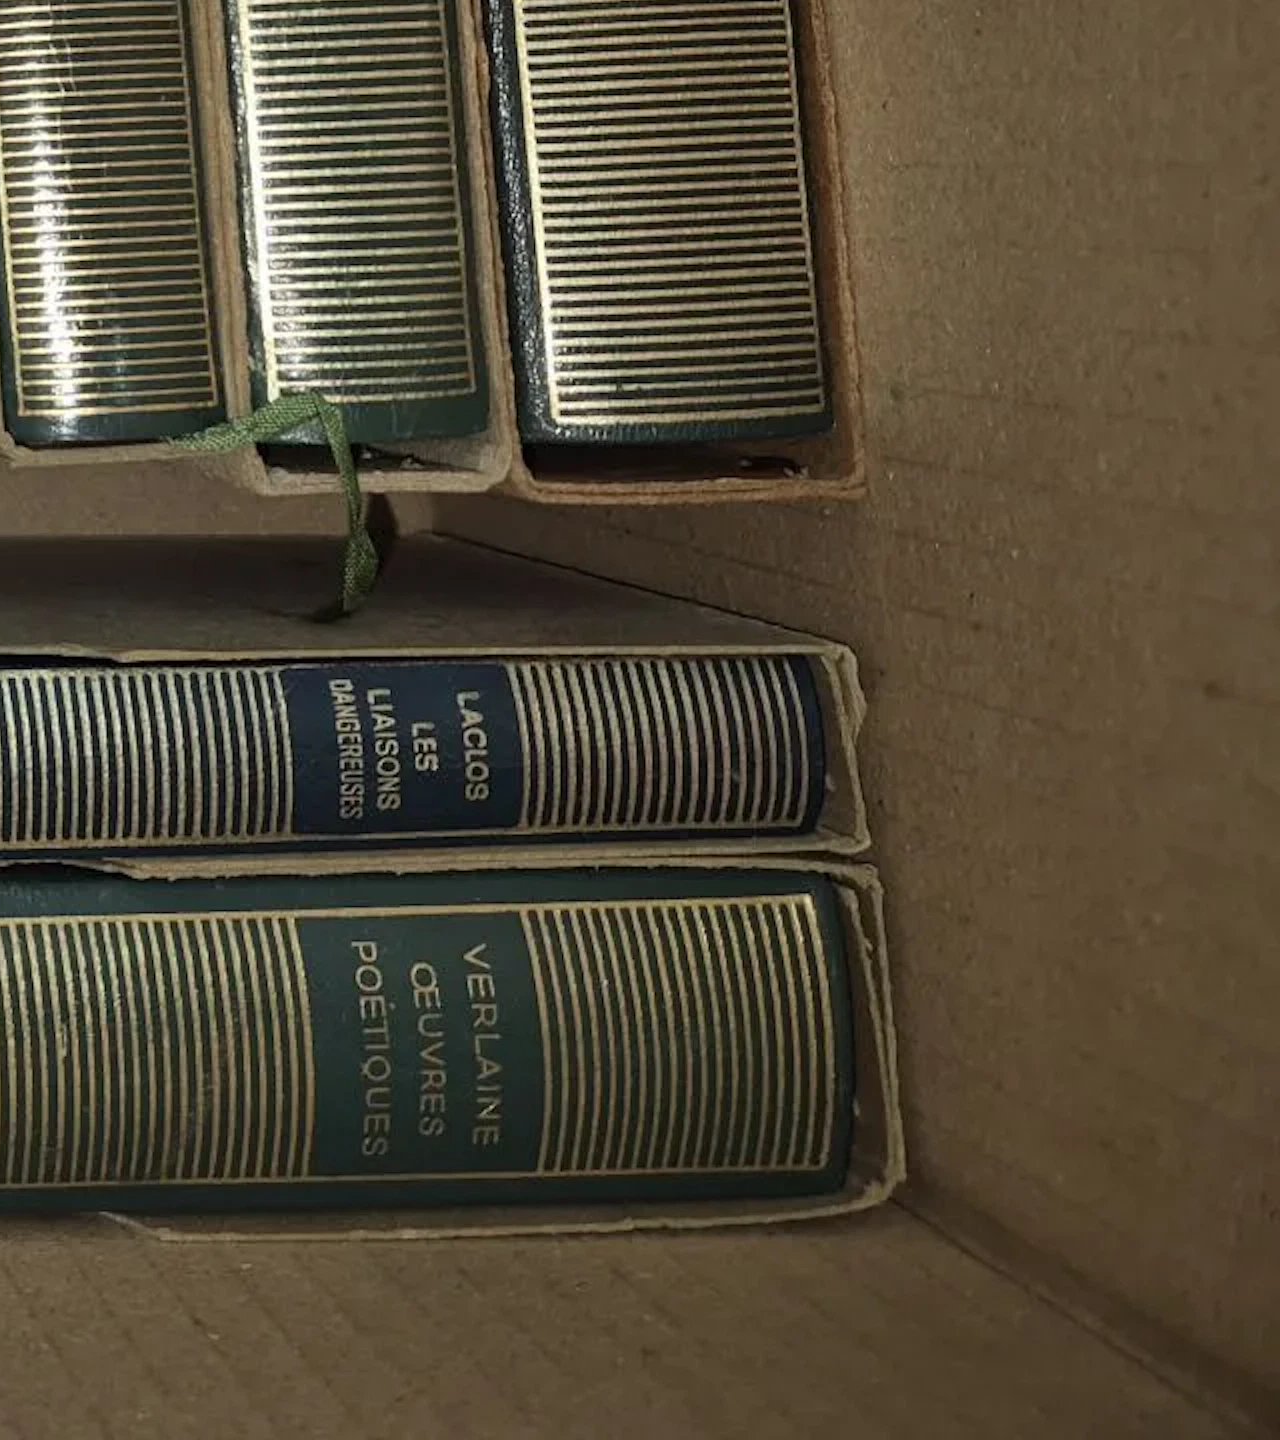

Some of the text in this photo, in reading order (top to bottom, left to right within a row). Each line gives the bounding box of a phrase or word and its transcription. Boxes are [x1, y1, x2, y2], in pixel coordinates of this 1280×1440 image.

[329, 678, 362, 820] DANGEREUSES
[367, 688, 400, 810] LIAISONS
[411, 721, 438, 771] LES
[456, 690, 488, 801] LACLOS
[351, 940, 396, 1157] POÉTIQUES
[410, 962, 447, 1137] ŒUVRES
[463, 943, 499, 1146] VERLAINE
